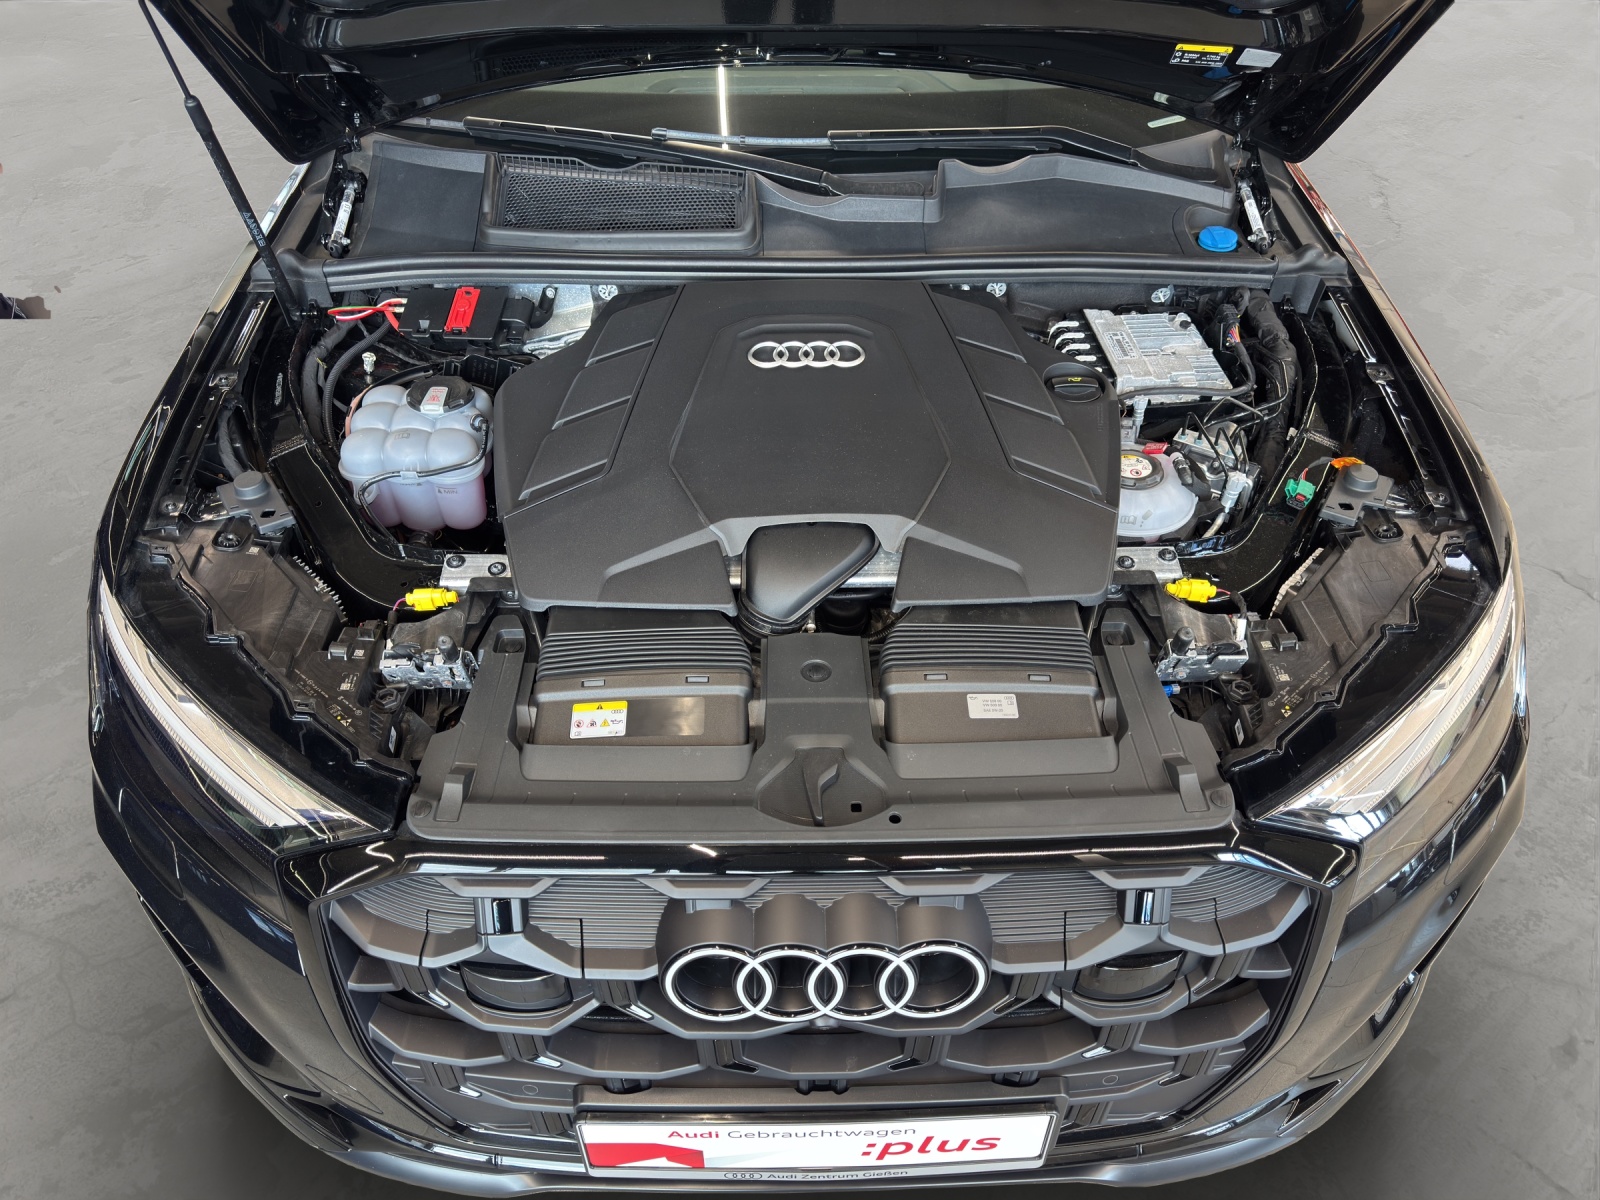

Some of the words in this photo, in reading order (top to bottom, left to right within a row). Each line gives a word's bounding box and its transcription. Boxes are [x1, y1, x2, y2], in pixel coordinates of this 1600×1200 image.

[667, 1130, 719, 1139] Audi
[728, 1127, 916, 1139] Gebrauchtwagen
[861, 1136, 1001, 1160] :plus
[863, 1170, 908, 1178] Gießen
